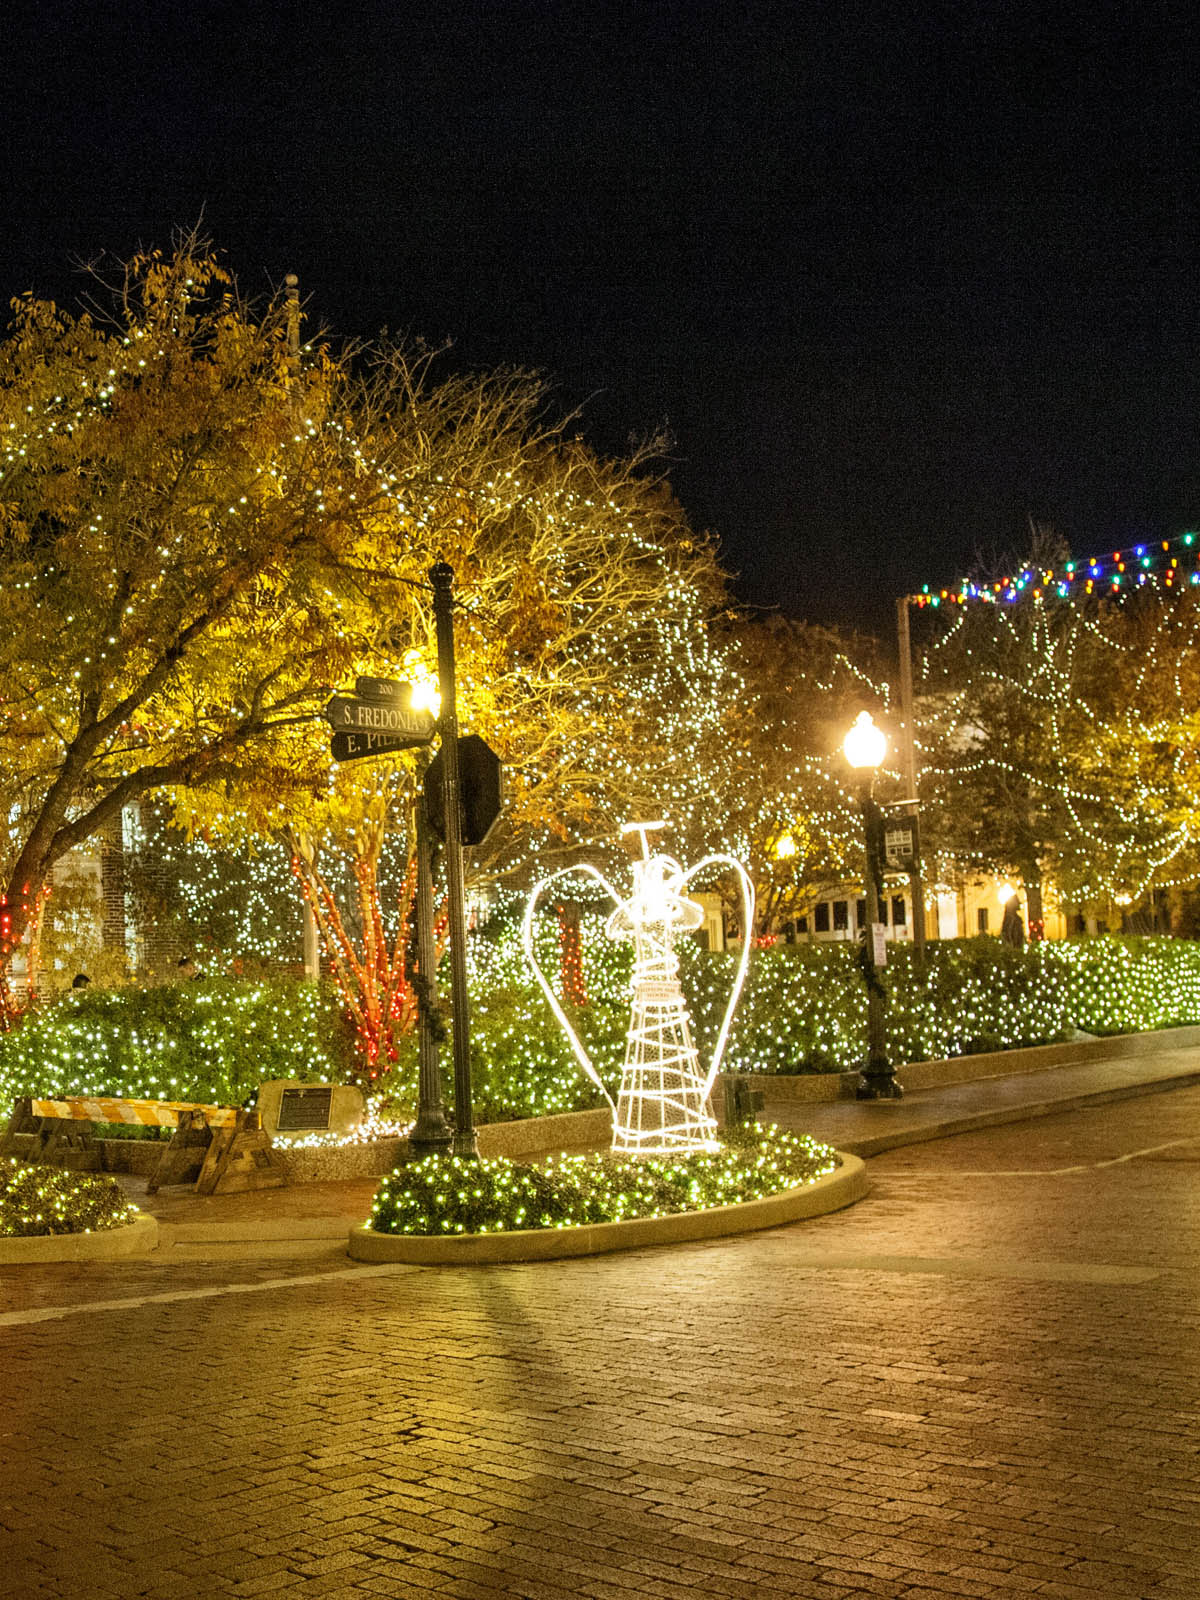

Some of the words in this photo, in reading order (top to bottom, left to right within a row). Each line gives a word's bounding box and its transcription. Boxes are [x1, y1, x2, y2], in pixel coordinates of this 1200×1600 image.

[378, 684, 393, 695] 200
[344, 705, 354, 725] S.
[358, 706, 419, 731] FREDONIA
[347, 735, 361, 753] E.
[367, 733, 409, 749] PIL
